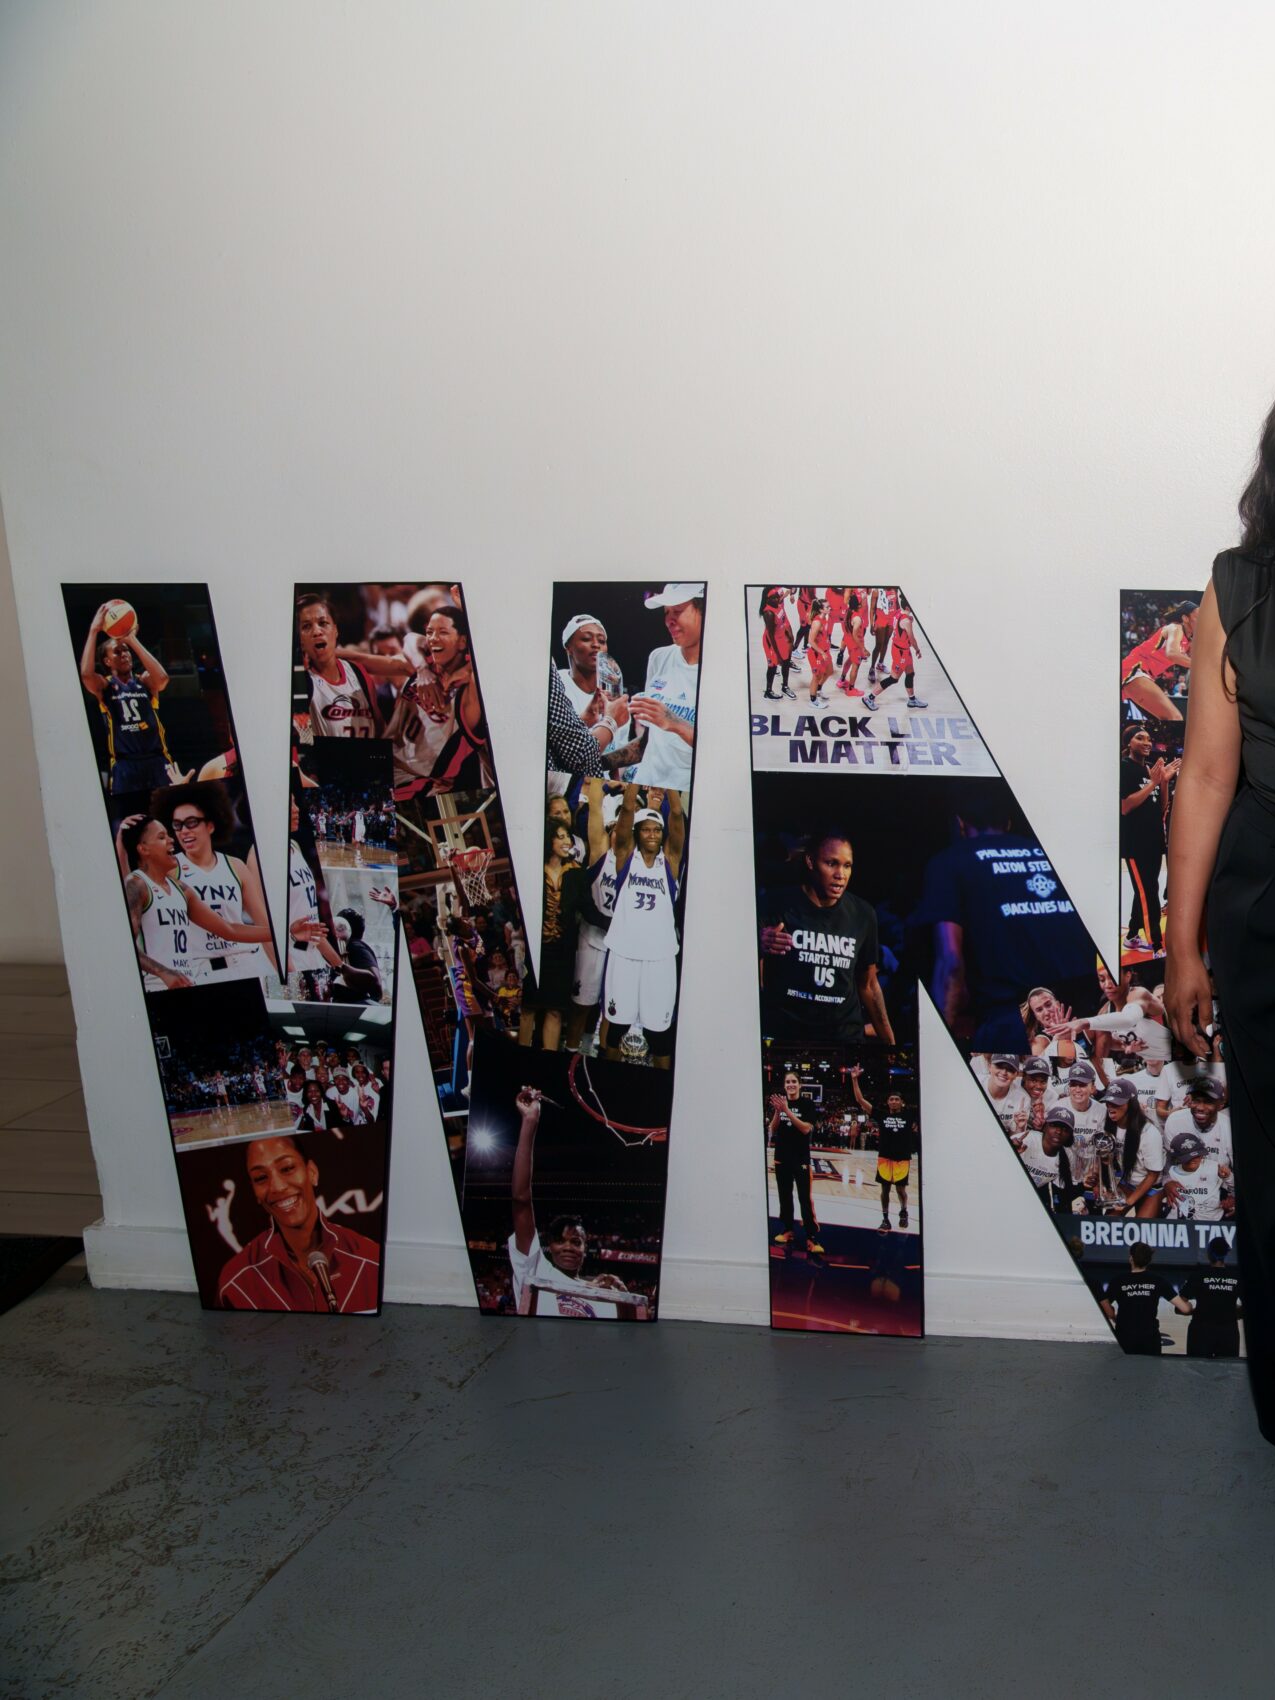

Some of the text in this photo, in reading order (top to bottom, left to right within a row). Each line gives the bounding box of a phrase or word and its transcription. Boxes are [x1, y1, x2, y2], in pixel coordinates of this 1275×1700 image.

[752, 714, 979, 740] BLACK LIVE
[789, 739, 962, 767] MATTER
[992, 861, 1027, 874] ALTON
[193, 885, 238, 902] YNX
[634, 892, 656, 911] 33
[1030, 900, 1057, 914] LIVES
[157, 908, 190, 926] LYN
[173, 929, 188, 953] 10
[791, 929, 856, 958] CHANGE
[798, 951, 851, 969] STARTS WITH
[814, 966, 835, 988] US
[1080, 1221, 1189, 1248] BREONNA
[1222, 1277, 1238, 1285] HER
